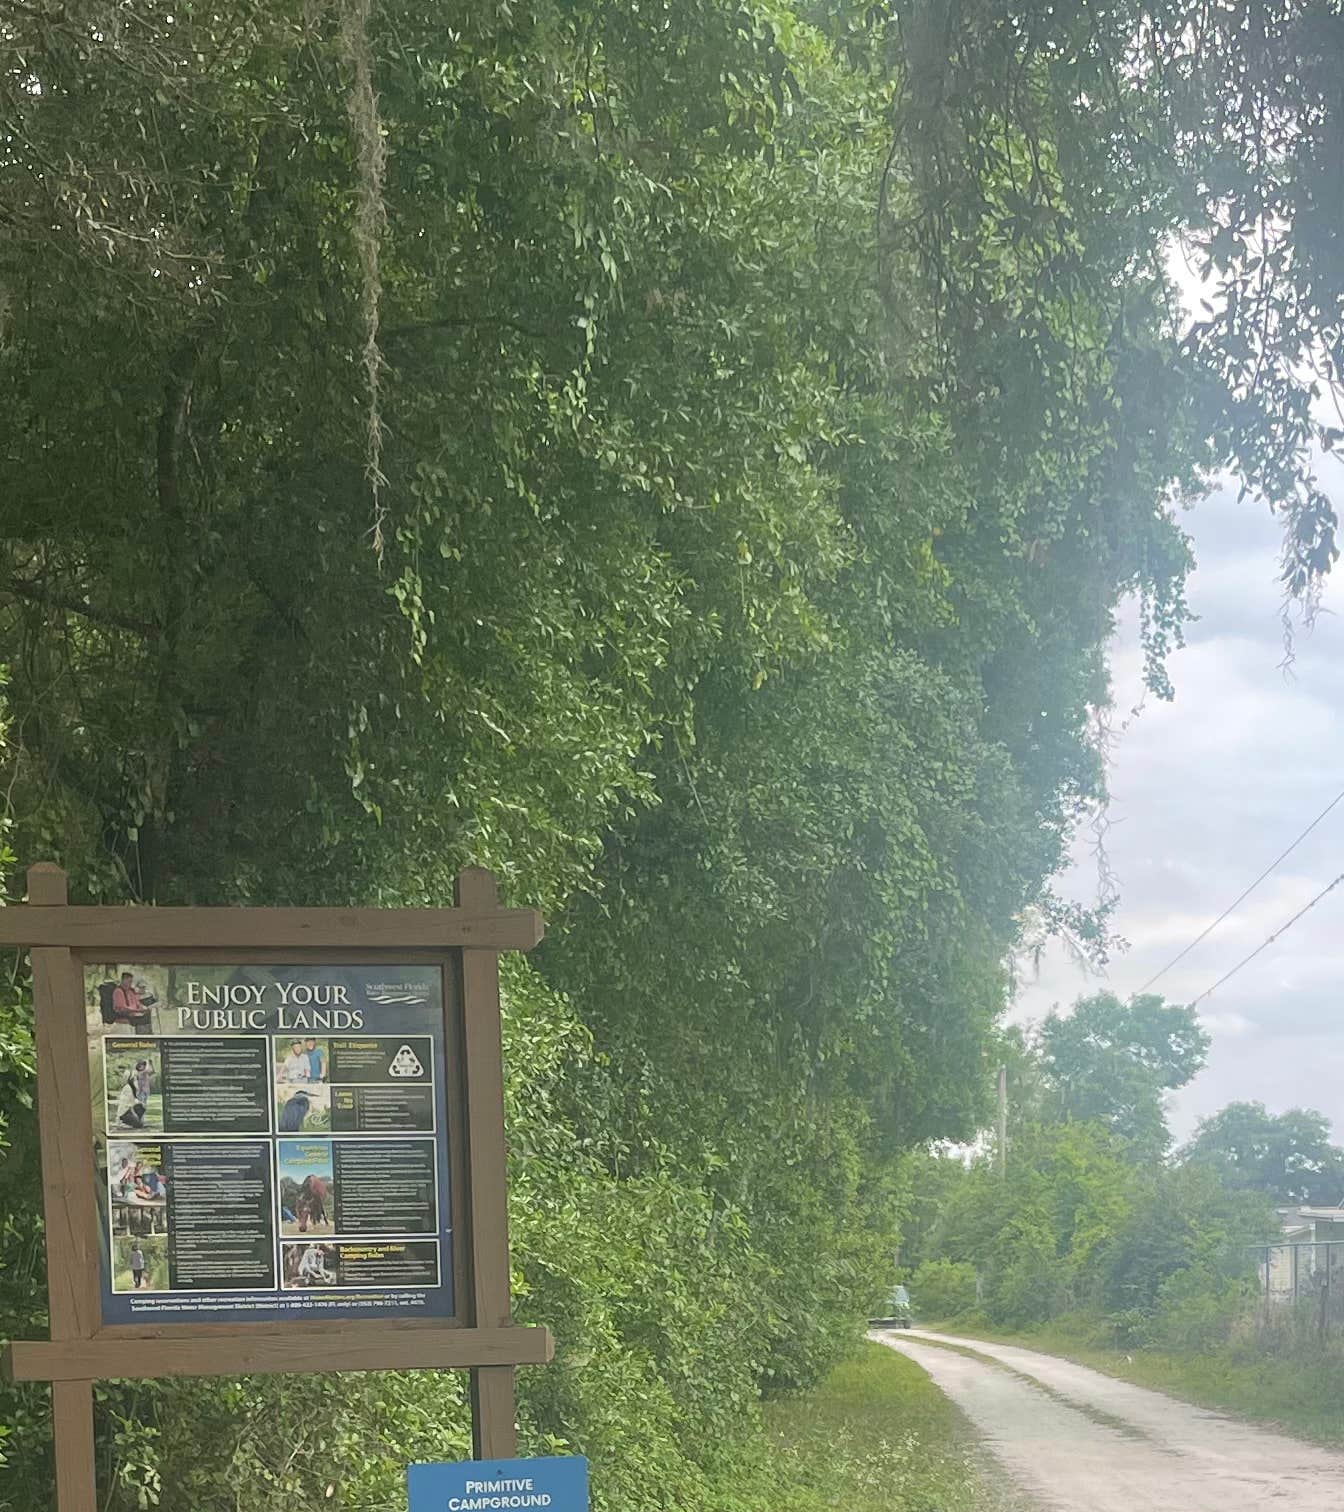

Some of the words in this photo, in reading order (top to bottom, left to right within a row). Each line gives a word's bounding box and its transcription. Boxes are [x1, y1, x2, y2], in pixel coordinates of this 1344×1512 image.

[186, 982, 267, 1009] ENJOY
[275, 982, 351, 1005] YOUR
[177, 1007, 267, 1030] PUBLIC
[276, 1007, 364, 1030] LANDS
[466, 1479, 533, 1494] PRIMITIVE
[448, 1494, 551, 1511] CAMPGROUND
